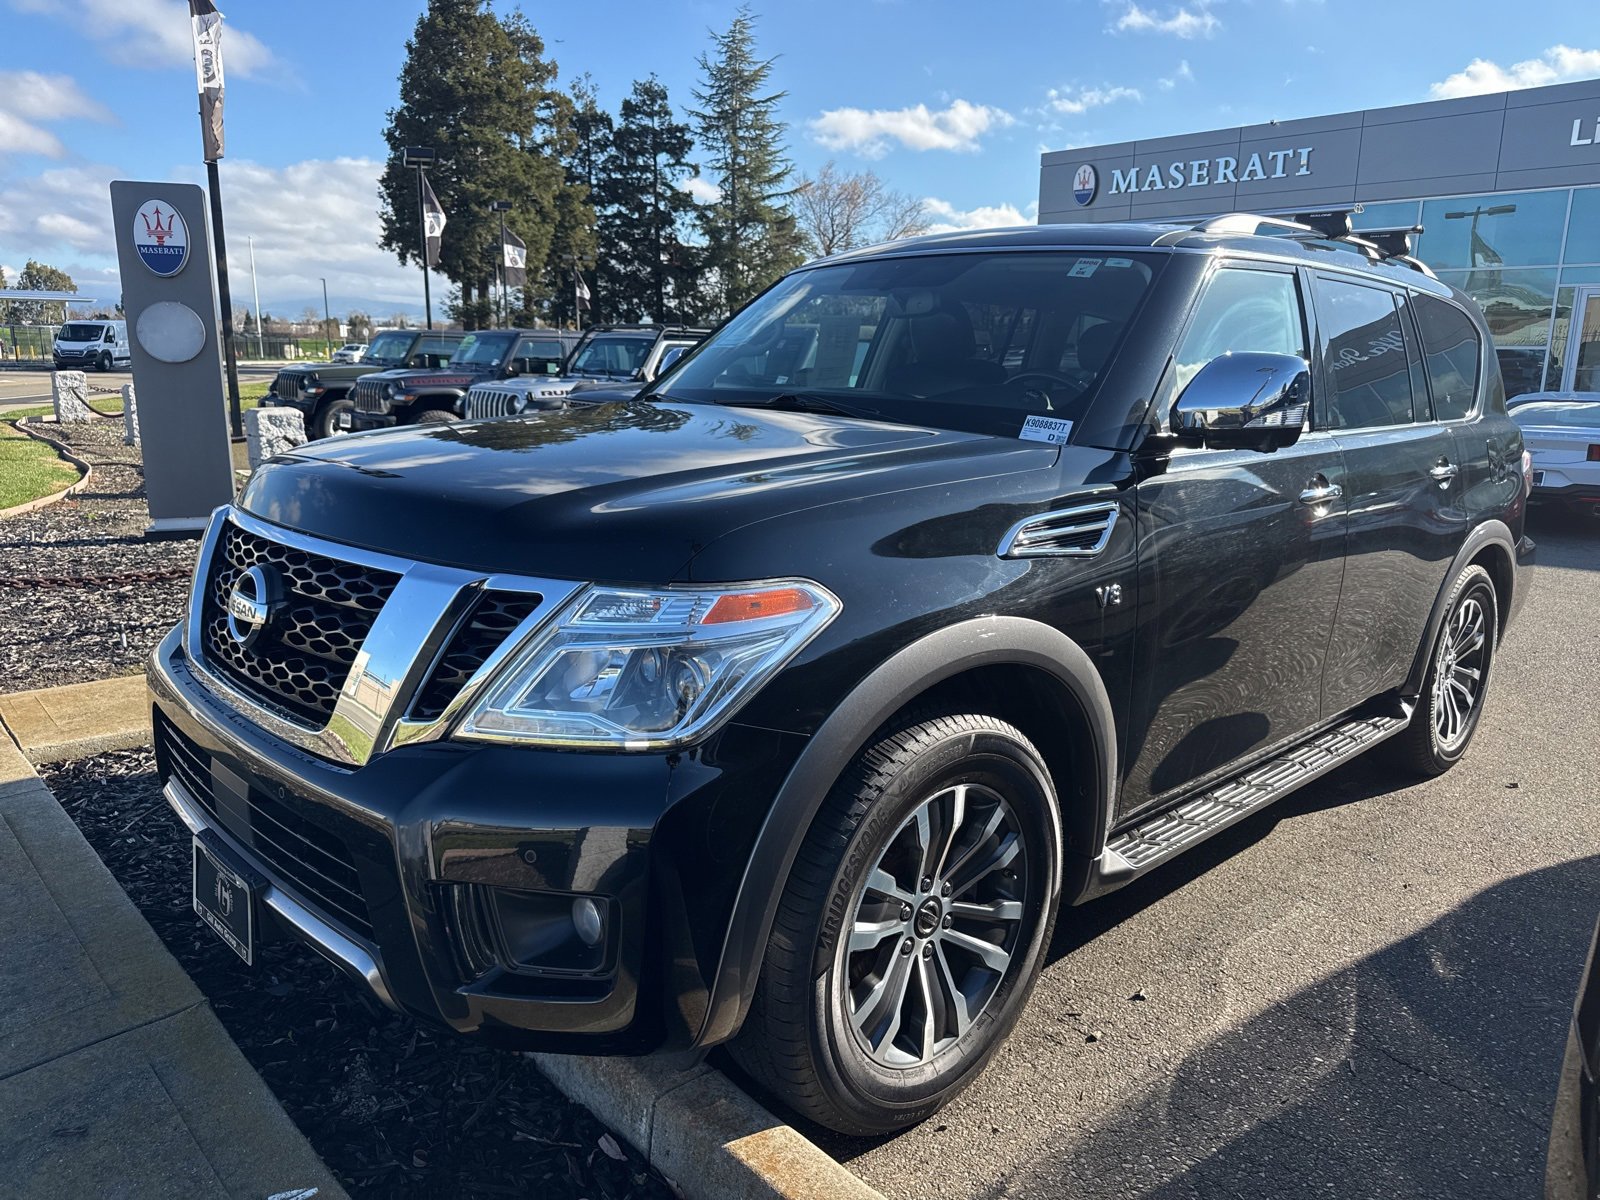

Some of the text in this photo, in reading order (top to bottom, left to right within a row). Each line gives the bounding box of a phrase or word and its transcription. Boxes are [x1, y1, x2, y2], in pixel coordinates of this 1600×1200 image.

[1570, 116, 1600, 146] Li
[1108, 147, 1313, 194] MASERATI
[140, 246, 184, 255] MASERATI
[1047, 433, 1055, 441] D
[1095, 583, 1122, 608] V8
[230, 597, 257, 619] SSAN
